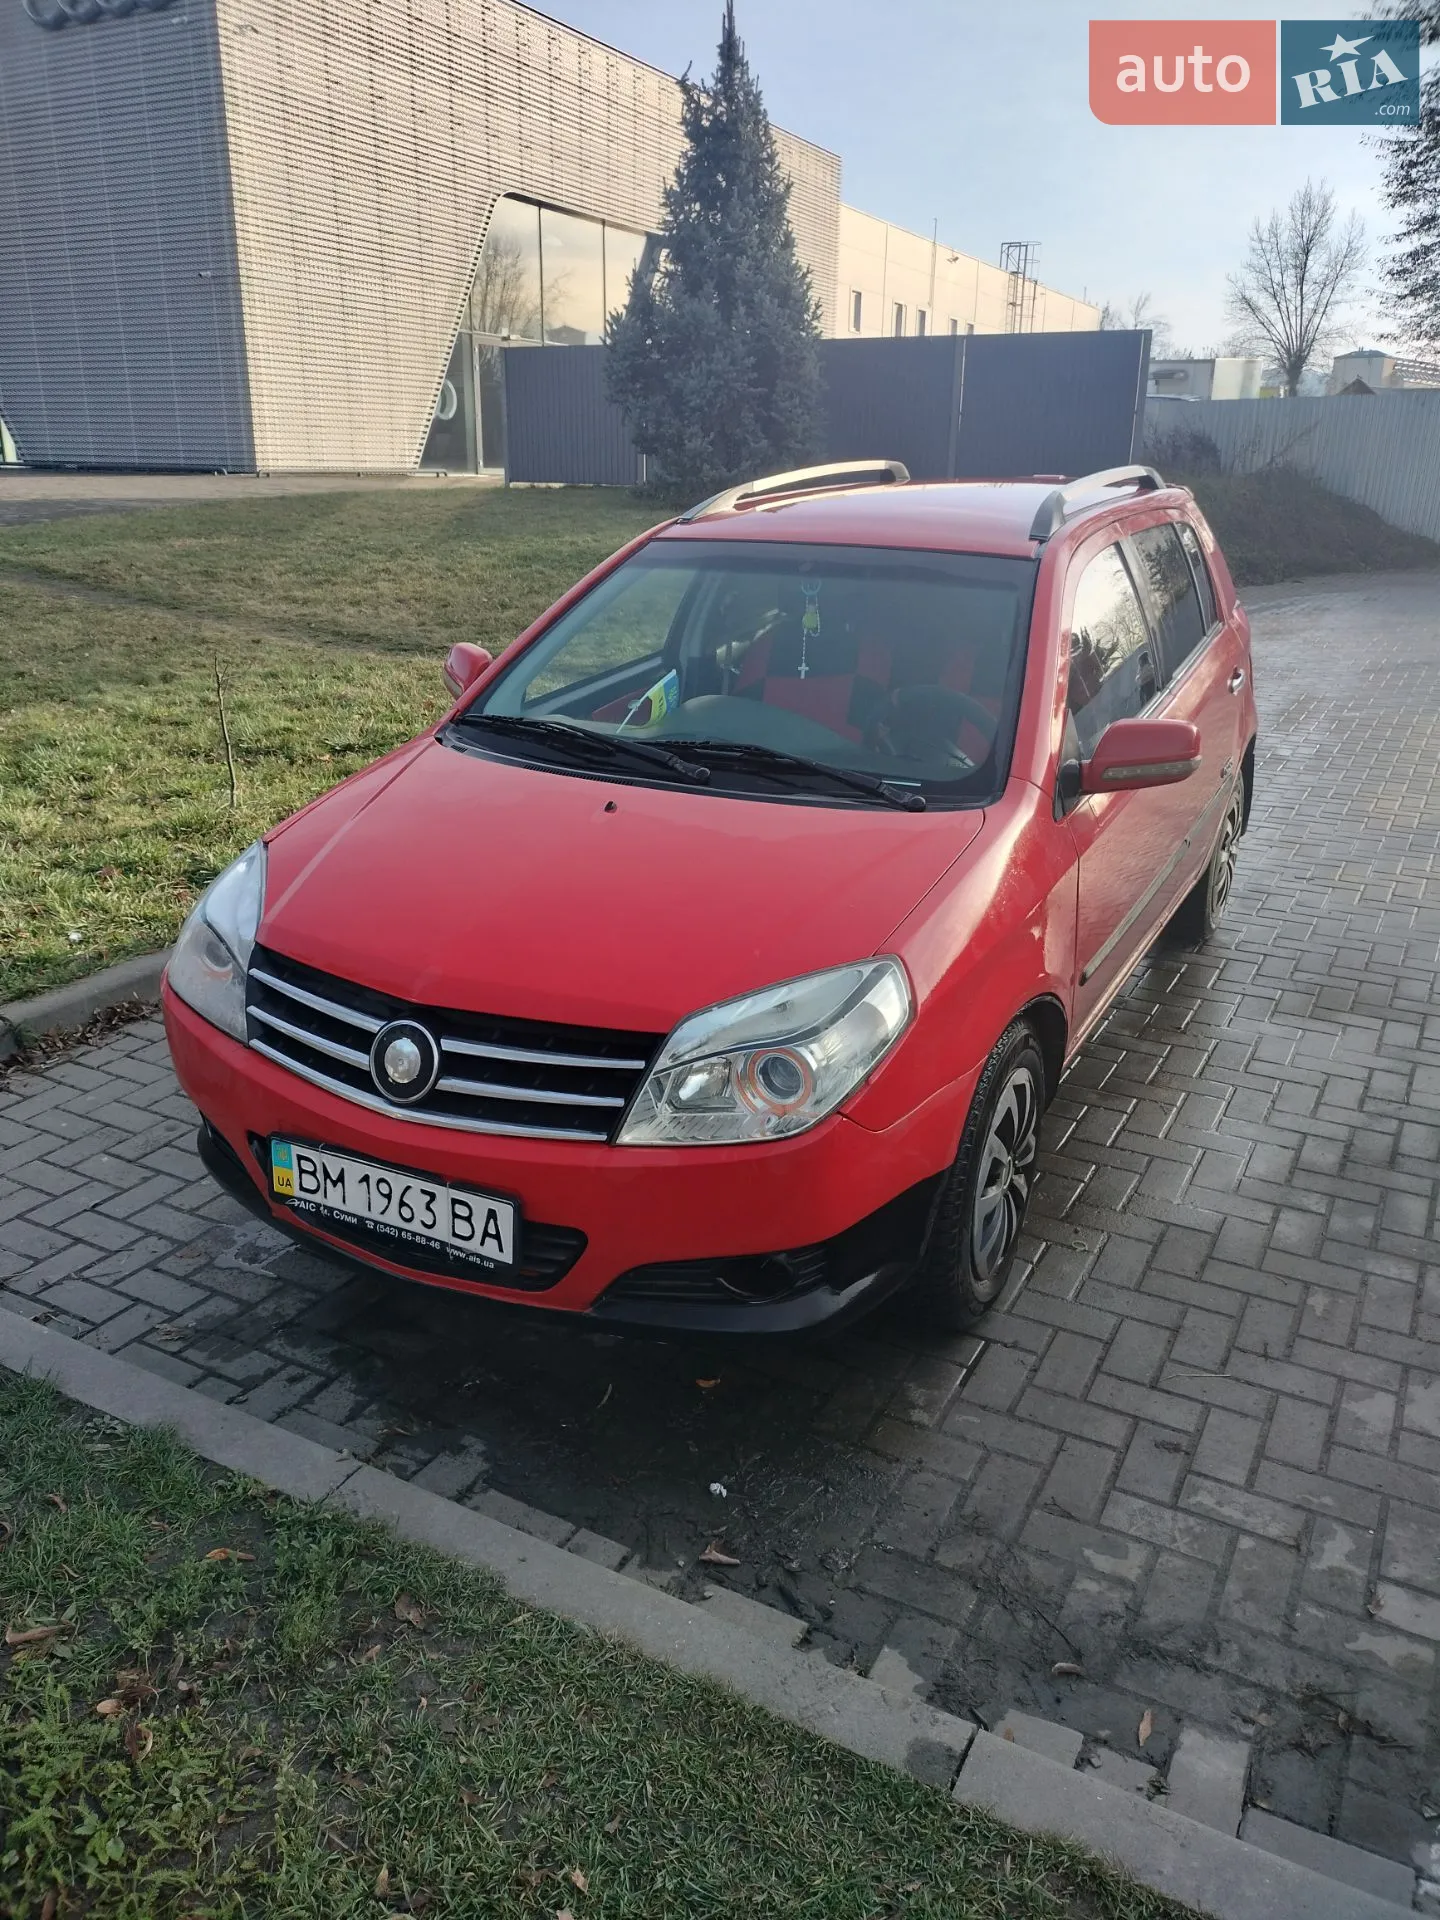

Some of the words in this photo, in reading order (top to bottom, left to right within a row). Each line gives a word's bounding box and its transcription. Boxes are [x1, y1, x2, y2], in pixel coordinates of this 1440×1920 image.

[277, 1175, 293, 1189] UA
[296, 1153, 346, 1205] BM
[358, 1173, 437, 1230] 1963
[450, 1197, 505, 1254] BA
[376, 1223, 399, 1238] (542)
[401, 1231, 441, 1250] 65-88-46
[446, 1246, 495, 1269] www.ais.ua
